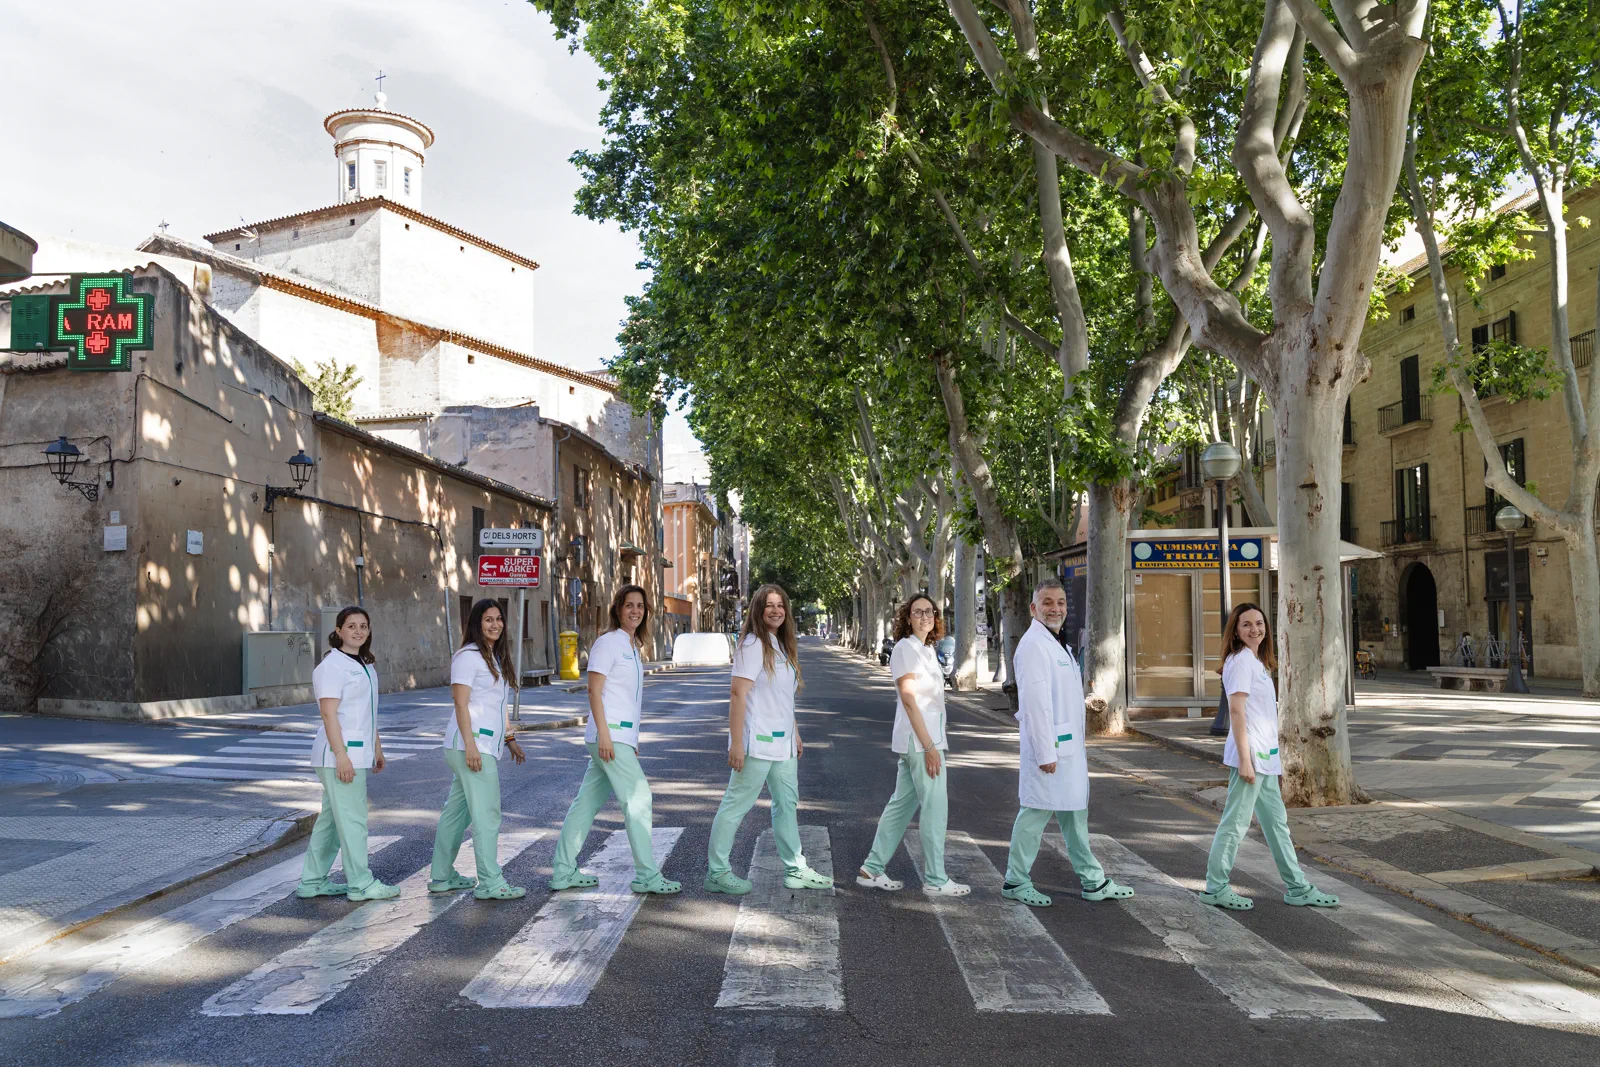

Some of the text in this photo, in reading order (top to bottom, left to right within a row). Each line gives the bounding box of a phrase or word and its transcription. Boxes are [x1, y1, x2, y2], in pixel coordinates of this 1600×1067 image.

[87, 313, 132, 330] RAM
[483, 531, 537, 540] C/ DELS HORTS
[1154, 541, 1239, 551] NUMISMÁTA
[504, 557, 534, 566] SUPER
[499, 565, 538, 573] MARKET
